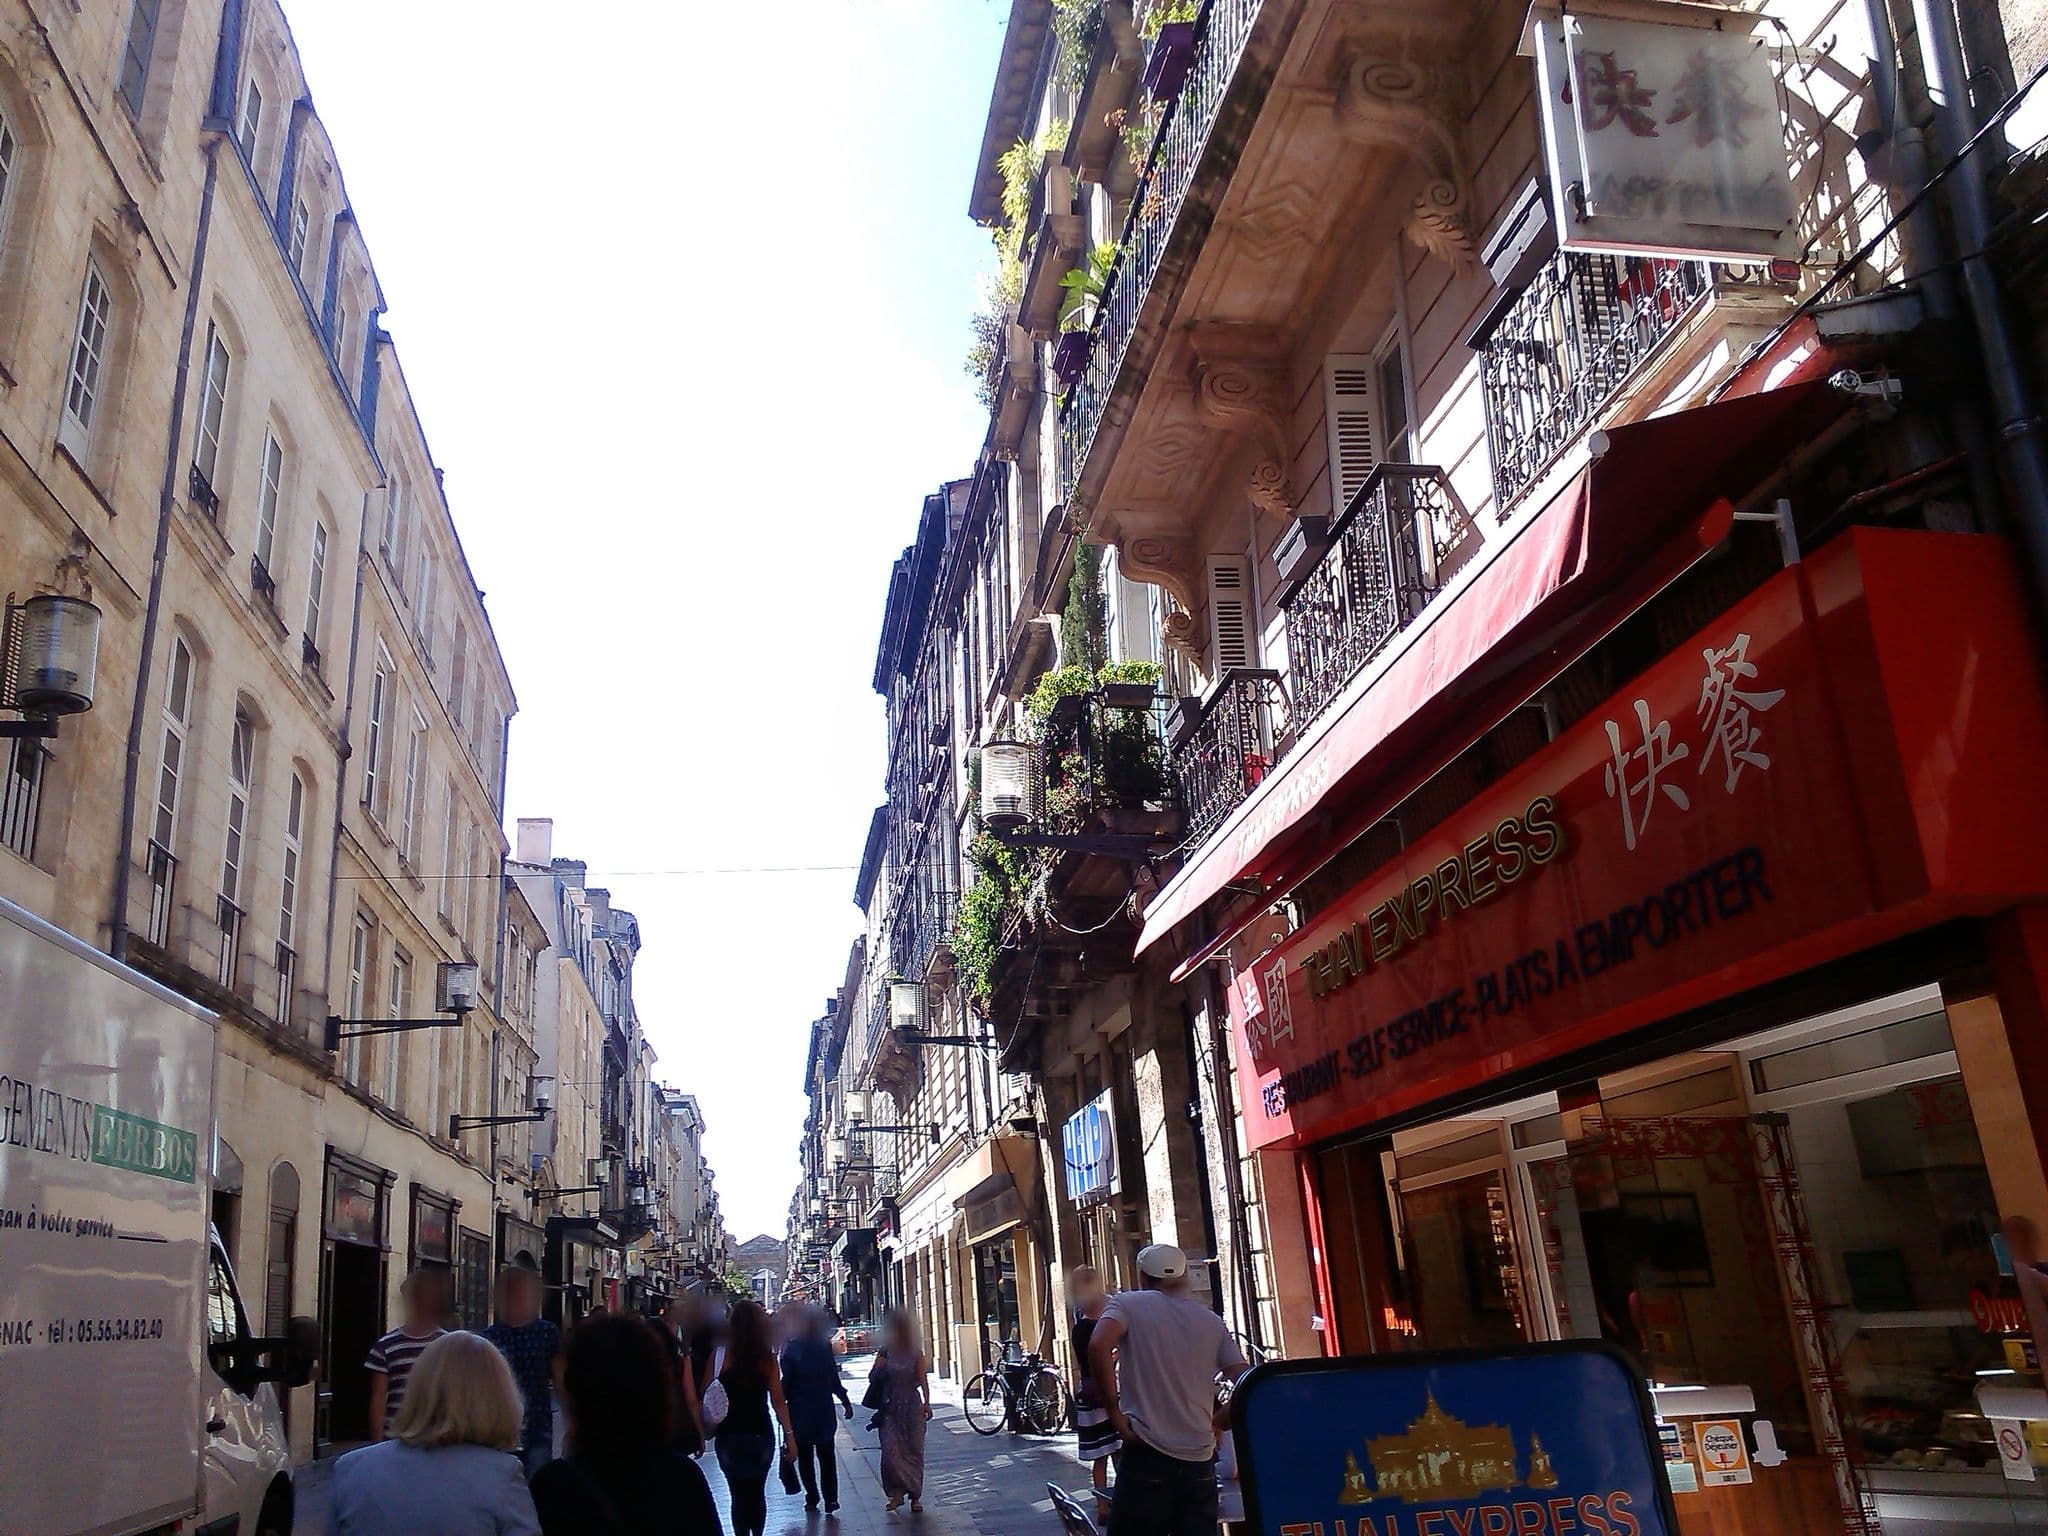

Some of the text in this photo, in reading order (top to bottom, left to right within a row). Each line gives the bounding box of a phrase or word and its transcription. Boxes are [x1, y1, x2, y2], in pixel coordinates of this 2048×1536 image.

[1604, 633, 1786, 851] 快餐
[1300, 796, 1559, 998] THAI EXPRESS
[1575, 845, 1773, 978] EMPORTER
[96, 1112, 195, 1177] FERBOS
[27, 1203, 37, 1230] à
[41, 1208, 73, 1234] votre
[0, 1319, 34, 1346] NAC
[48, 1318, 66, 1344] tél
[77, 1318, 163, 1343] 05.56.34.82.40
